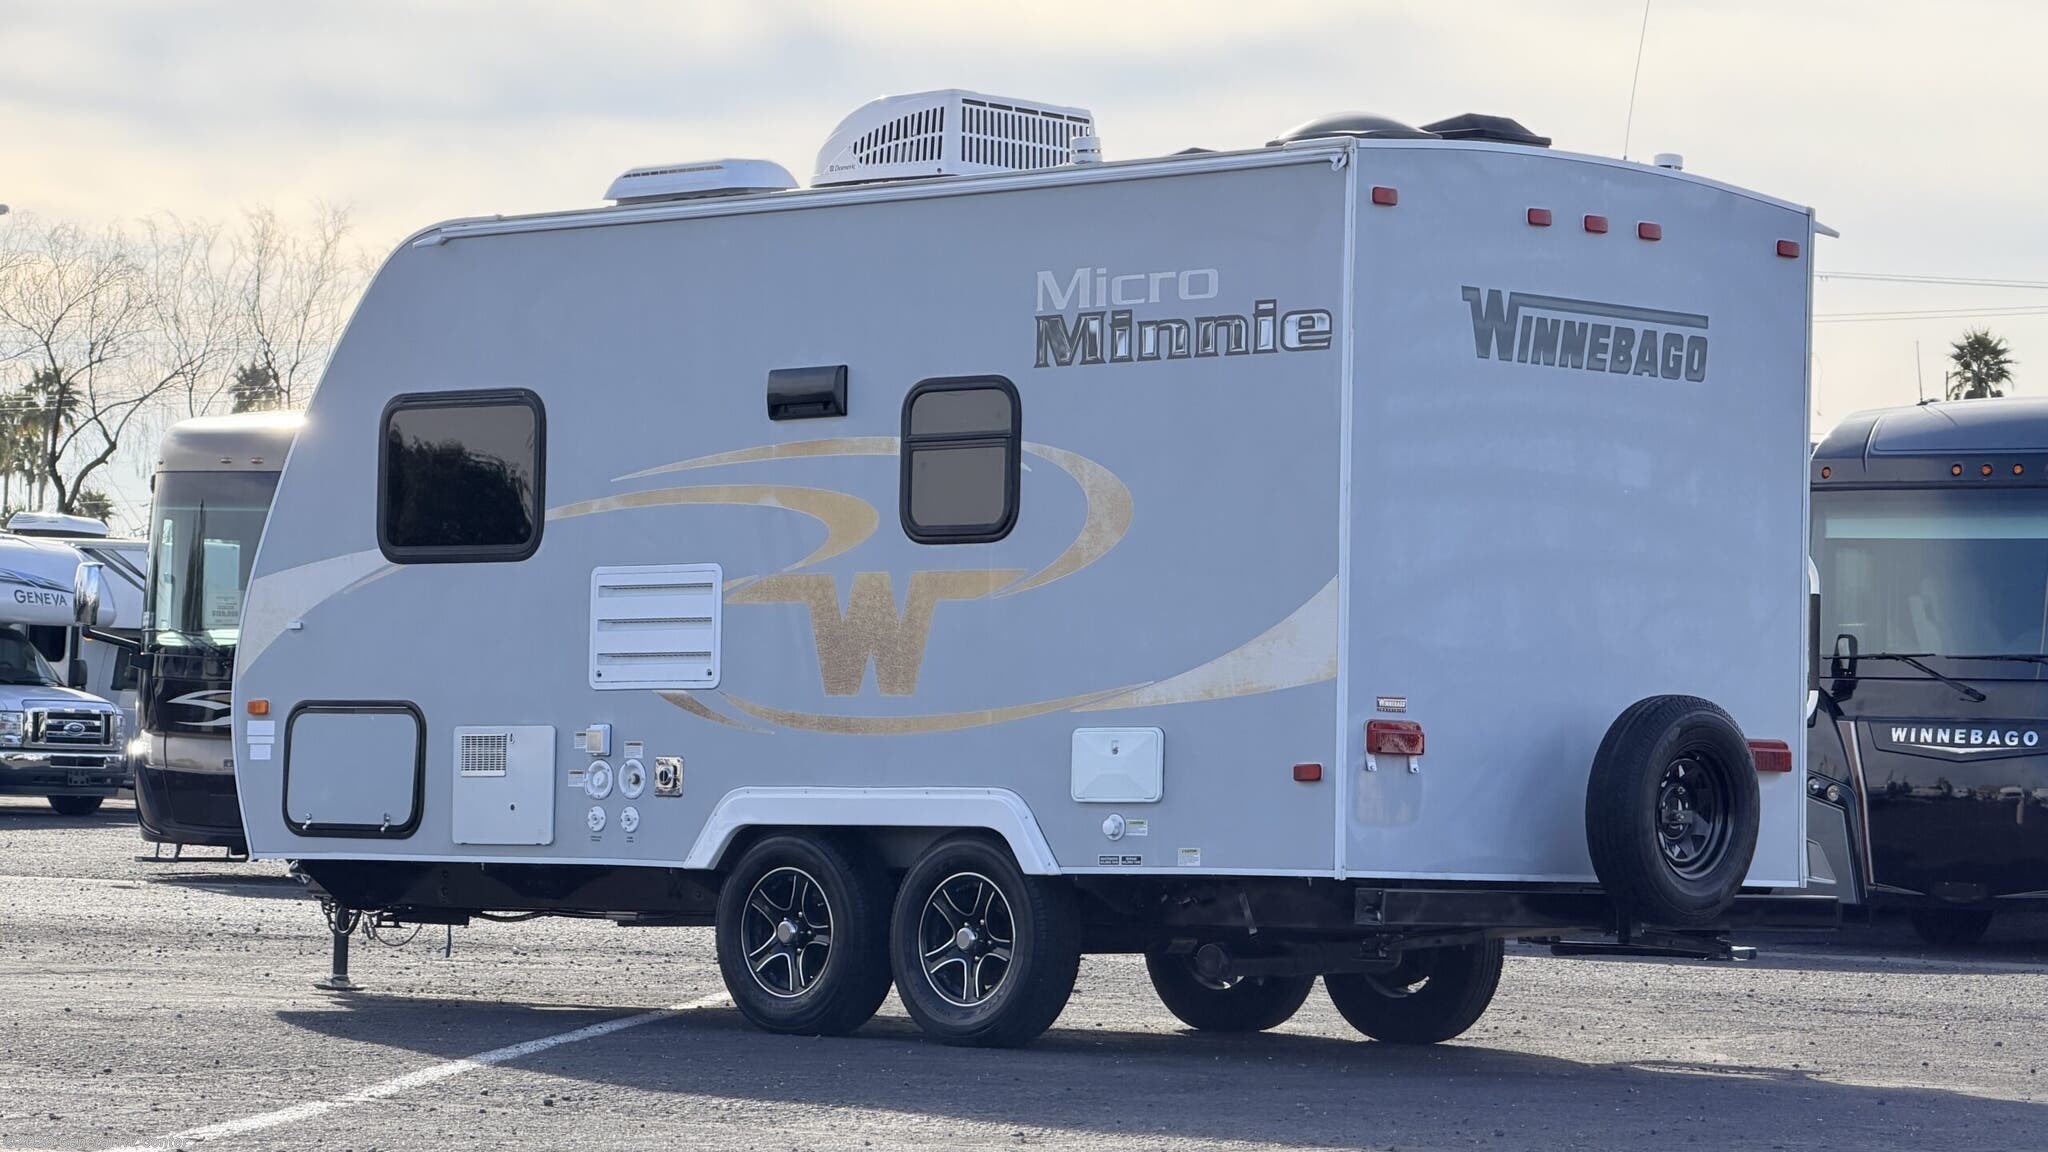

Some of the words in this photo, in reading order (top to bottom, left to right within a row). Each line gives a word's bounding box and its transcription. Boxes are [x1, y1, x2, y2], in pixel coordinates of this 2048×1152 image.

[1036, 267, 1219, 312] Micro
[1034, 299, 1333, 368] Minnie
[1461, 285, 1709, 382] WINNEBAGO
[14, 589, 67, 606] GENEVA
[1891, 727, 2039, 746] WINNEBAGO
